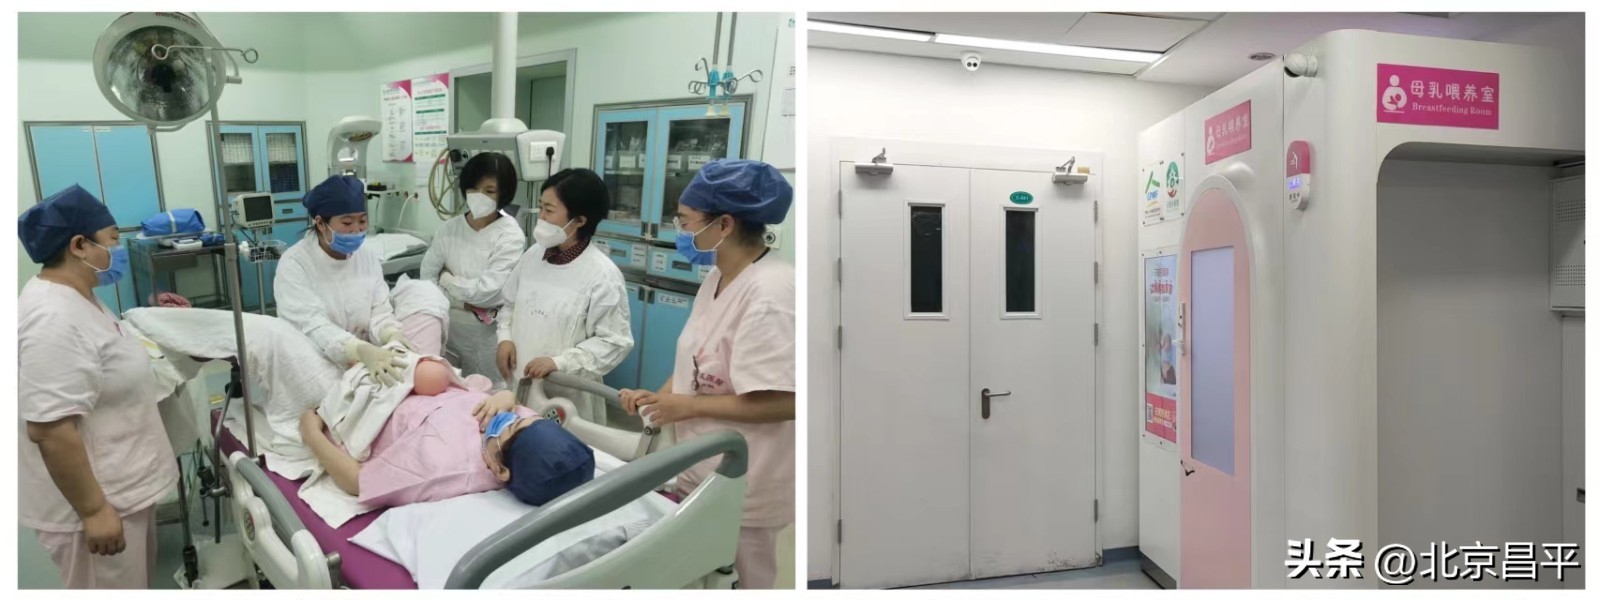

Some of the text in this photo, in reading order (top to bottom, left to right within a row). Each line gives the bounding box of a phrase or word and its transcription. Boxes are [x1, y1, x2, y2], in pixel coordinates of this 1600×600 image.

[1410, 80, 1495, 103] 母乳喂养室
[1412, 102, 1492, 116] Breastfeeding Room
[1215, 114, 1249, 138] 母乳喂养室
